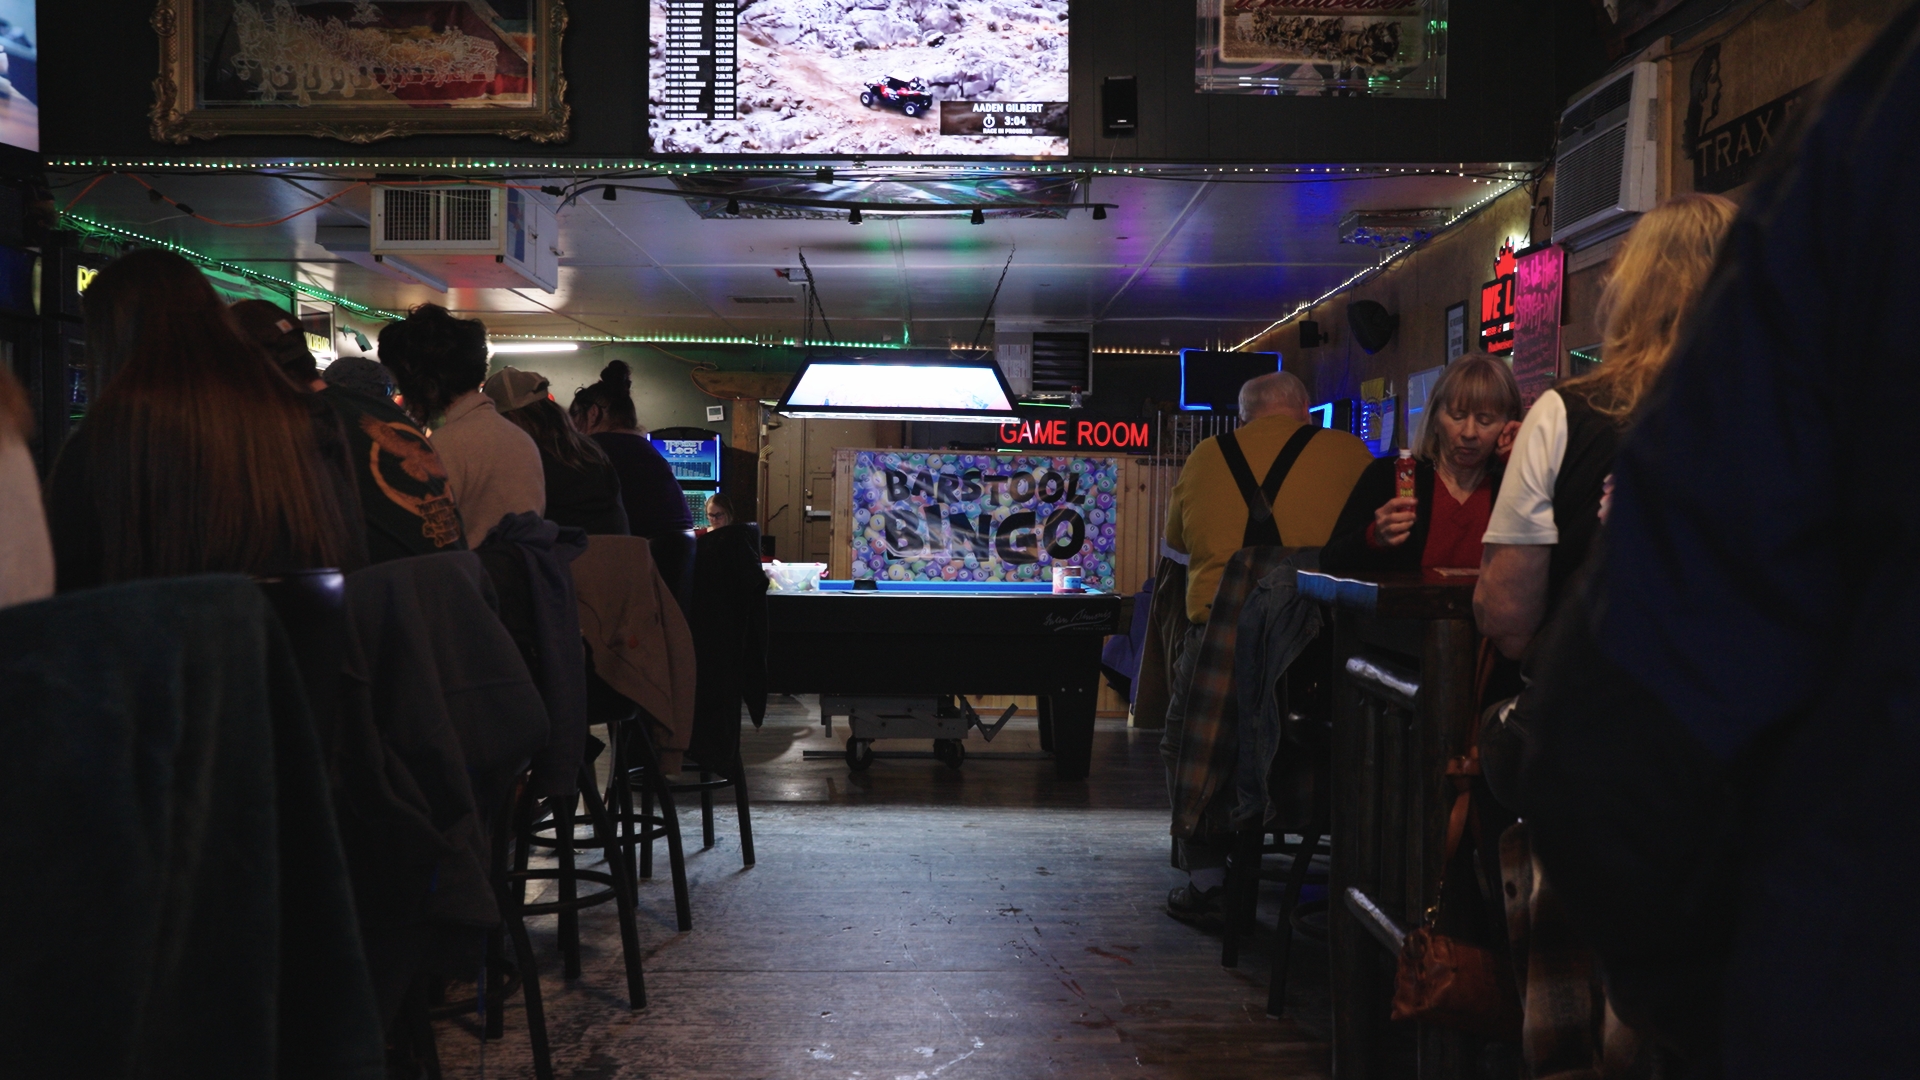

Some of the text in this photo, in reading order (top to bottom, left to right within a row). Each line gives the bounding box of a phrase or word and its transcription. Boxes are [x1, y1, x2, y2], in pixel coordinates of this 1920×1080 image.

[973, 103, 1043, 113] AADEN GILBERT
[1004, 116, 1026, 126] 3:04
[1697, 109, 1775, 177] TRAX
[1482, 283, 1503, 322] WE
[1000, 419, 1148, 447] GAME ROOM
[885, 470, 1085, 506] BARSTOOL
[884, 505, 1085, 565] BINGO
